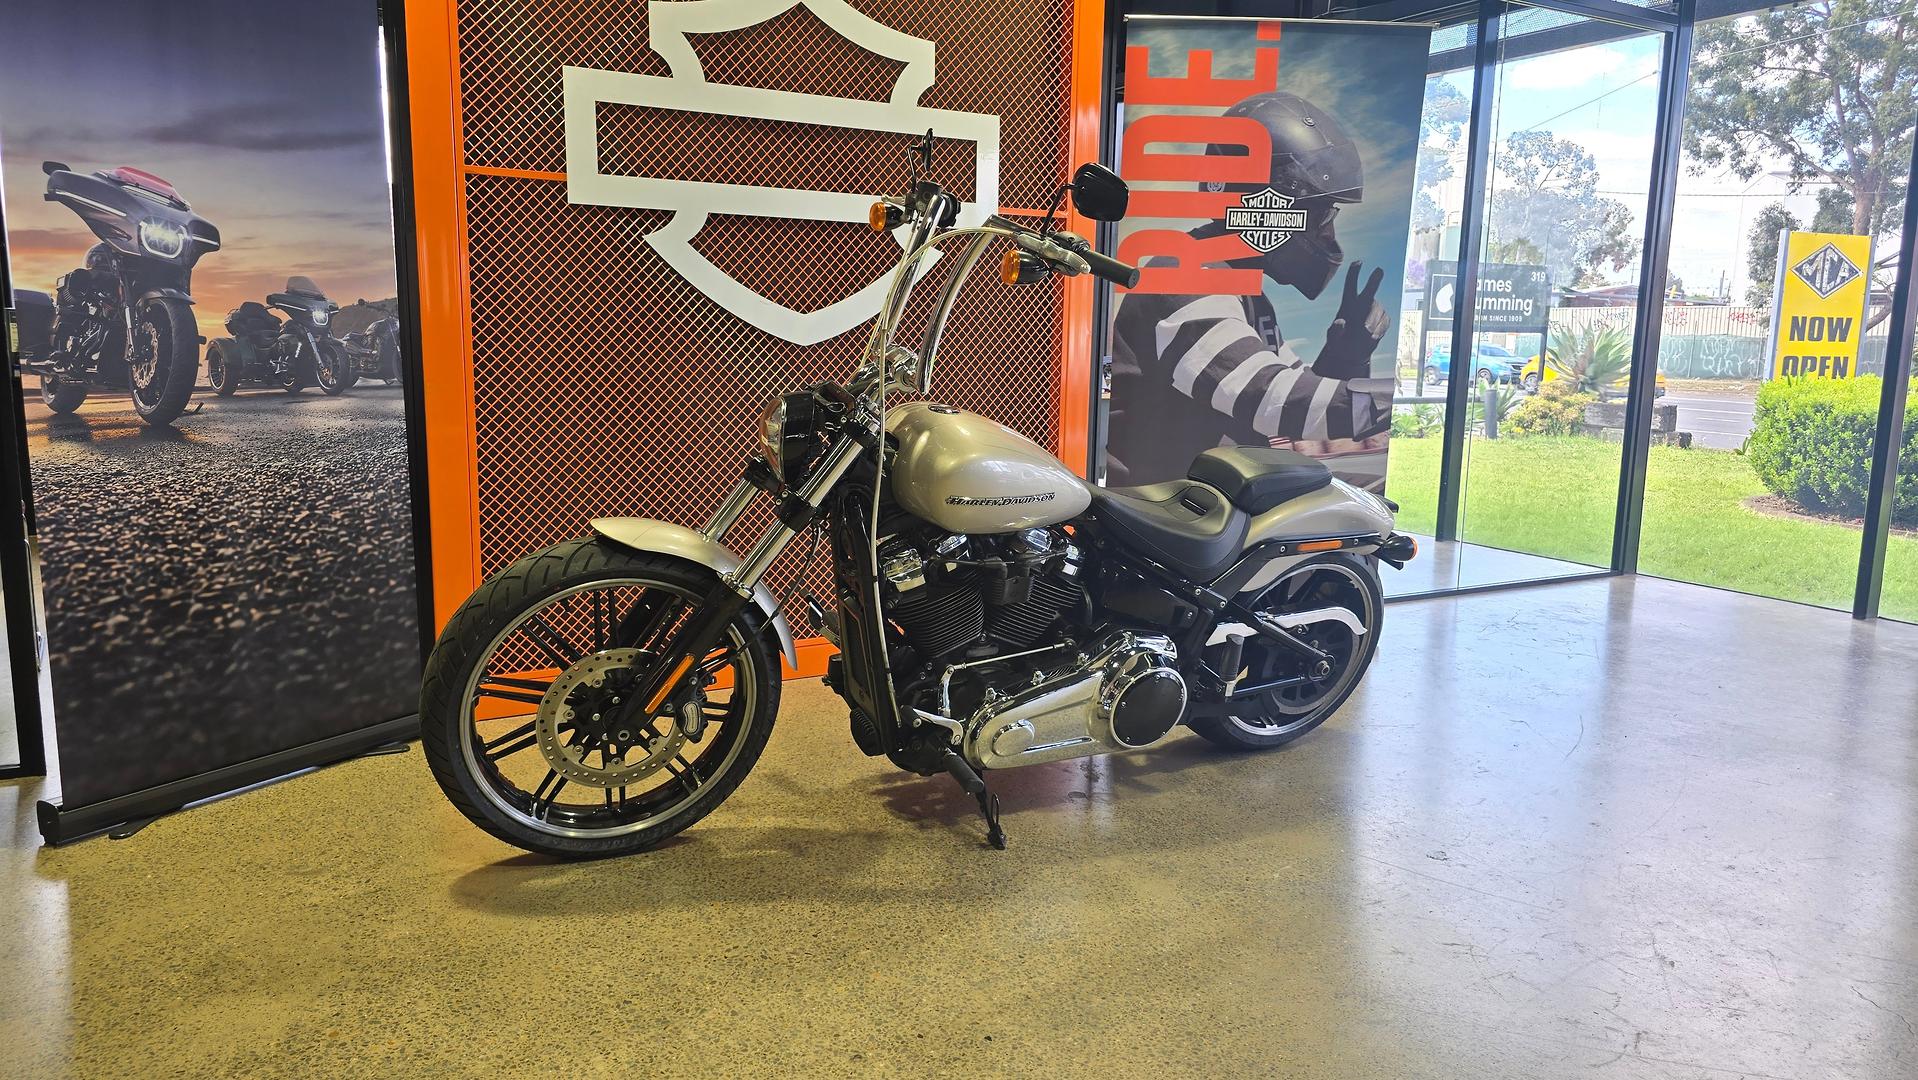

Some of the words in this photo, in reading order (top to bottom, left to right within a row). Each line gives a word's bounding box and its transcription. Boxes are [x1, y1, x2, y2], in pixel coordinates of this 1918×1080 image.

[1114, 21, 1282, 296] RIDE.
[1248, 191, 1288, 209] MOTOR
[1230, 211, 1304, 228] HARLEY-DAVIDSON
[1246, 230, 1286, 249] CYCLES
[1476, 278, 1513, 293] ames
[1530, 271, 1546, 282] 319
[1475, 294, 1533, 316] umming
[1788, 315, 1853, 343] NOW
[1781, 355, 1850, 379] OPEN
